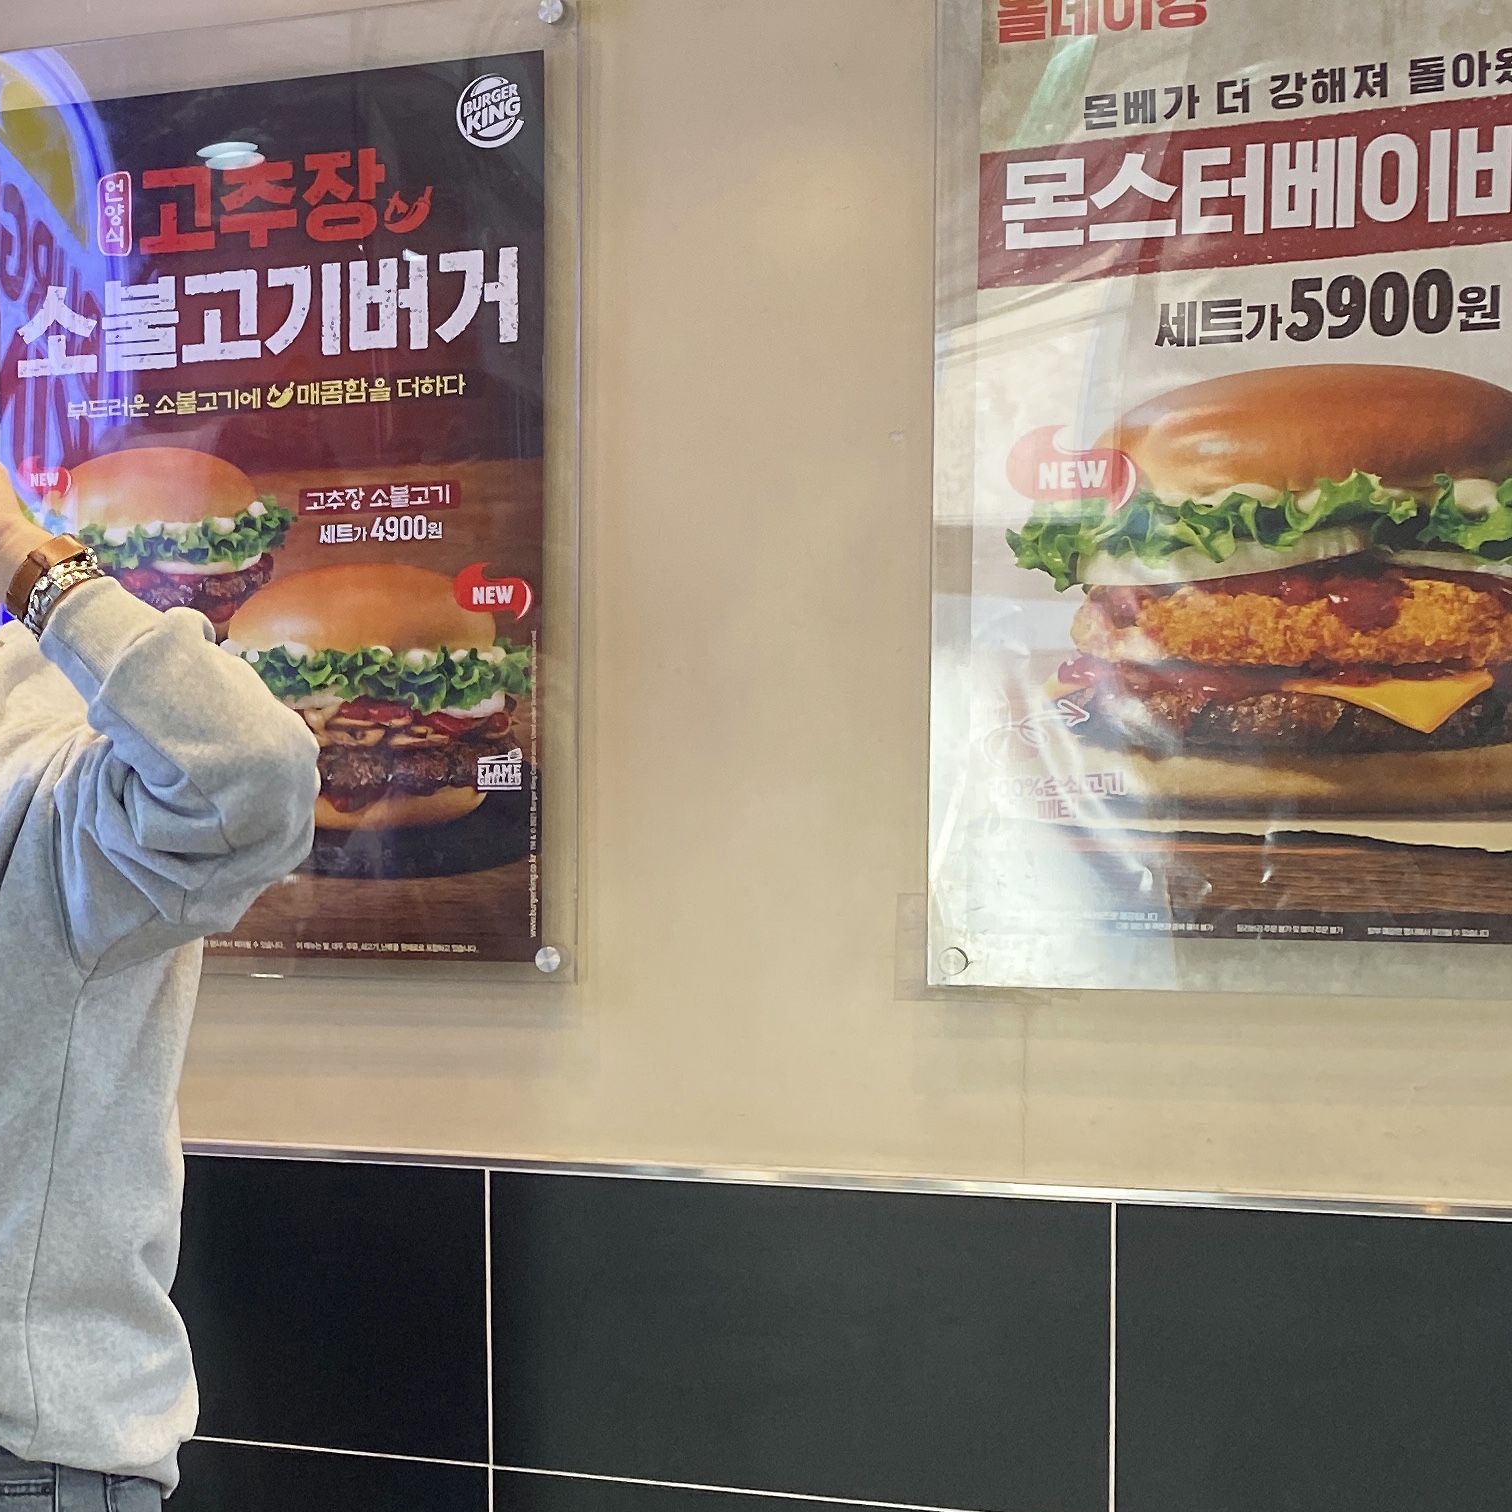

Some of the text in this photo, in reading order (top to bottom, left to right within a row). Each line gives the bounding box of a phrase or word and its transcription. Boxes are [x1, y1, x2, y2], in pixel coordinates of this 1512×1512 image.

[464, 84, 518, 117] BURGER
[1084, 85, 1200, 131] 몬베가
[1217, 79, 1250, 116] 더
[1269, 62, 1389, 111] 강해져
[467, 96, 521, 135] KING
[103, 147, 386, 256] 언양식 고추장
[17, 246, 520, 379] 소불고기버거
[67, 372, 467, 420] 부드러운 소불고기에 매콤함을 더하다
[30, 471, 60, 488] NEW
[1038, 459, 1108, 490] NEW
[305, 482, 452, 511] 고추장 소불고기
[370, 514, 444, 542] 4900원
[473, 584, 515, 607] NEW
[477, 762, 522, 776] FLAME
[477, 773, 522, 787] GRILLED
